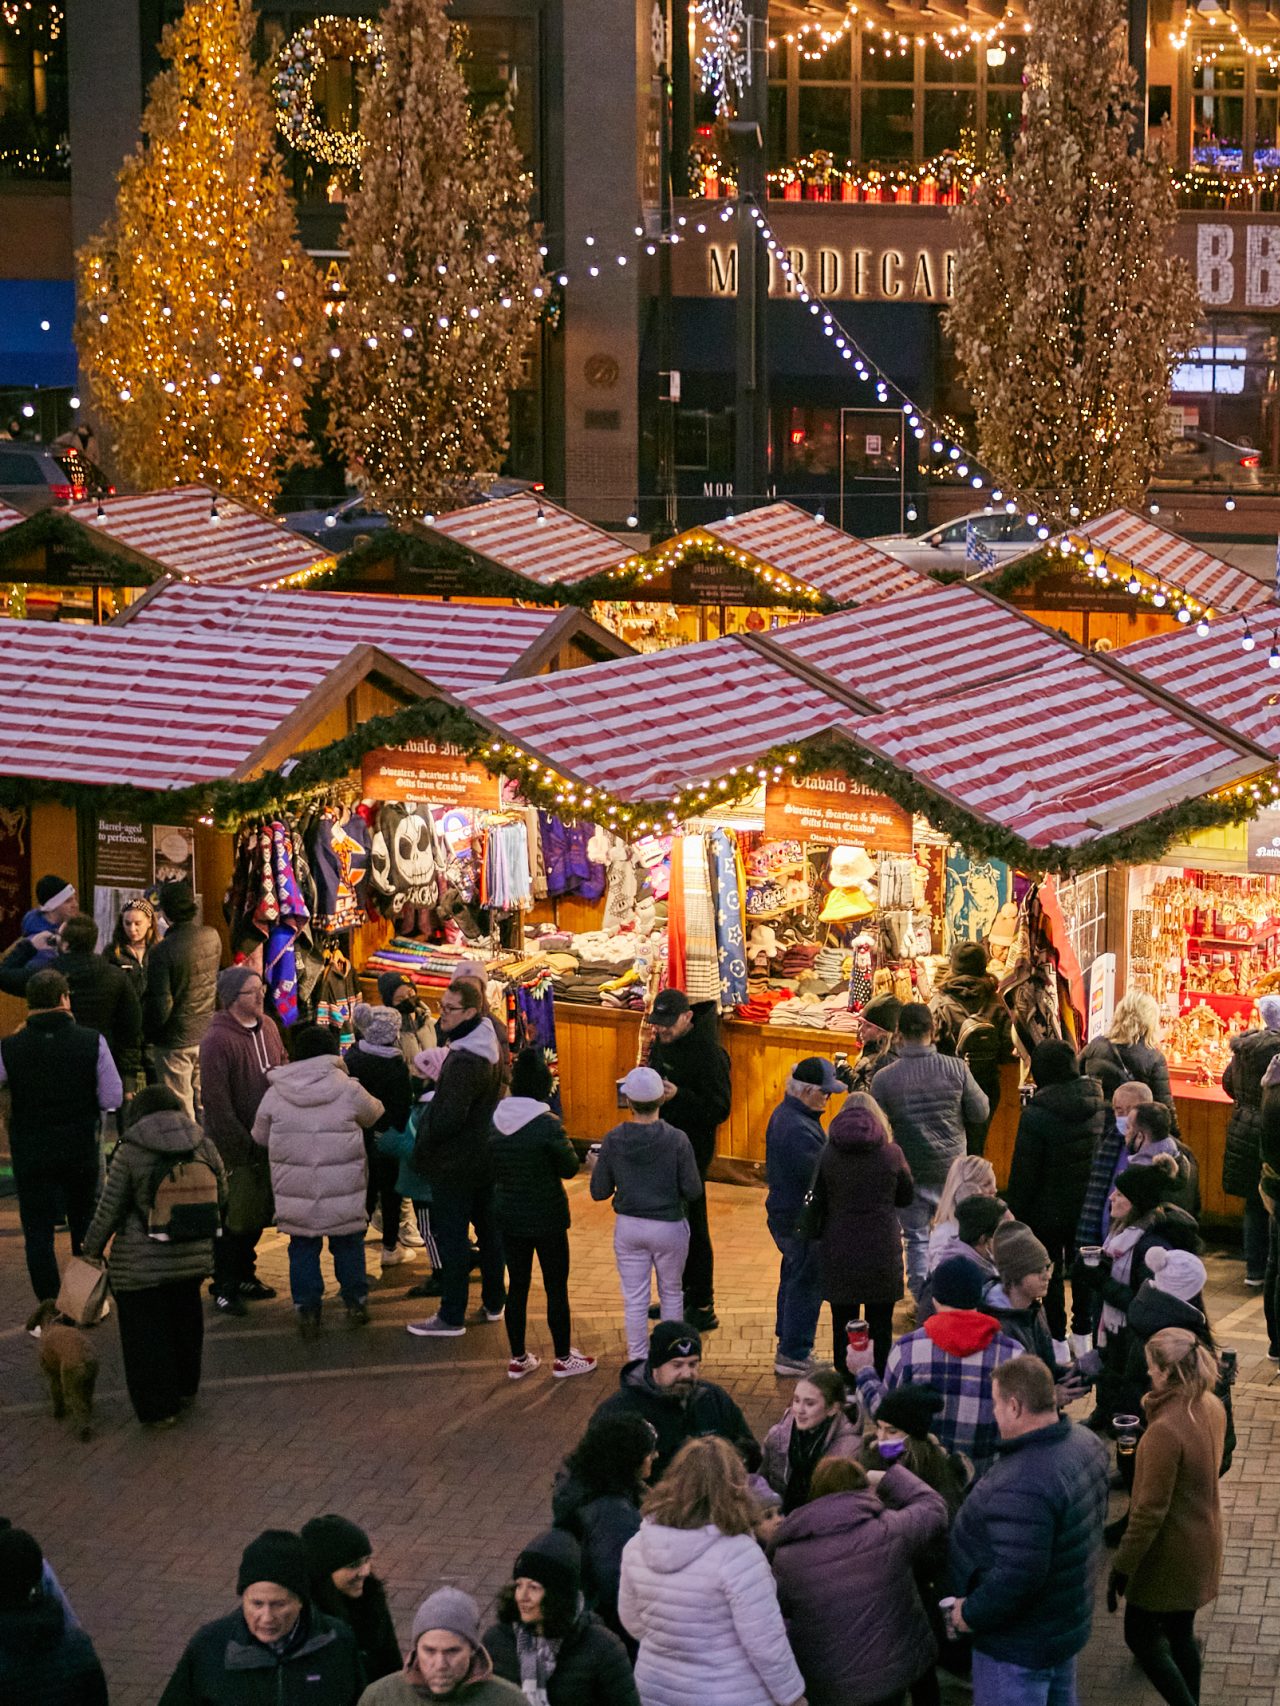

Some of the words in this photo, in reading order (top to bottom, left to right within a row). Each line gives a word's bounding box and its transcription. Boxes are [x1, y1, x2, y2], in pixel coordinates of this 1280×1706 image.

[380, 767, 418, 778] Sweaters,
[419, 770, 450, 781] Scarves
[451, 772, 459, 781] &
[396, 778, 416, 788] Gifts
[417, 779, 434, 789] from
[435, 781, 466, 792] Ecuador
[784, 804, 823, 818] Sweaters,
[825, 808, 858, 821] Scarves
[860, 812, 868, 822] &
[870, 813, 893, 825] Hats,
[98, 820, 142, 834] Barrel-aged
[801, 817, 821, 828] Gifts
[823, 819, 841, 829] from
[843, 821, 876, 834] Ecuador
[107, 833, 147, 844] perfection.
